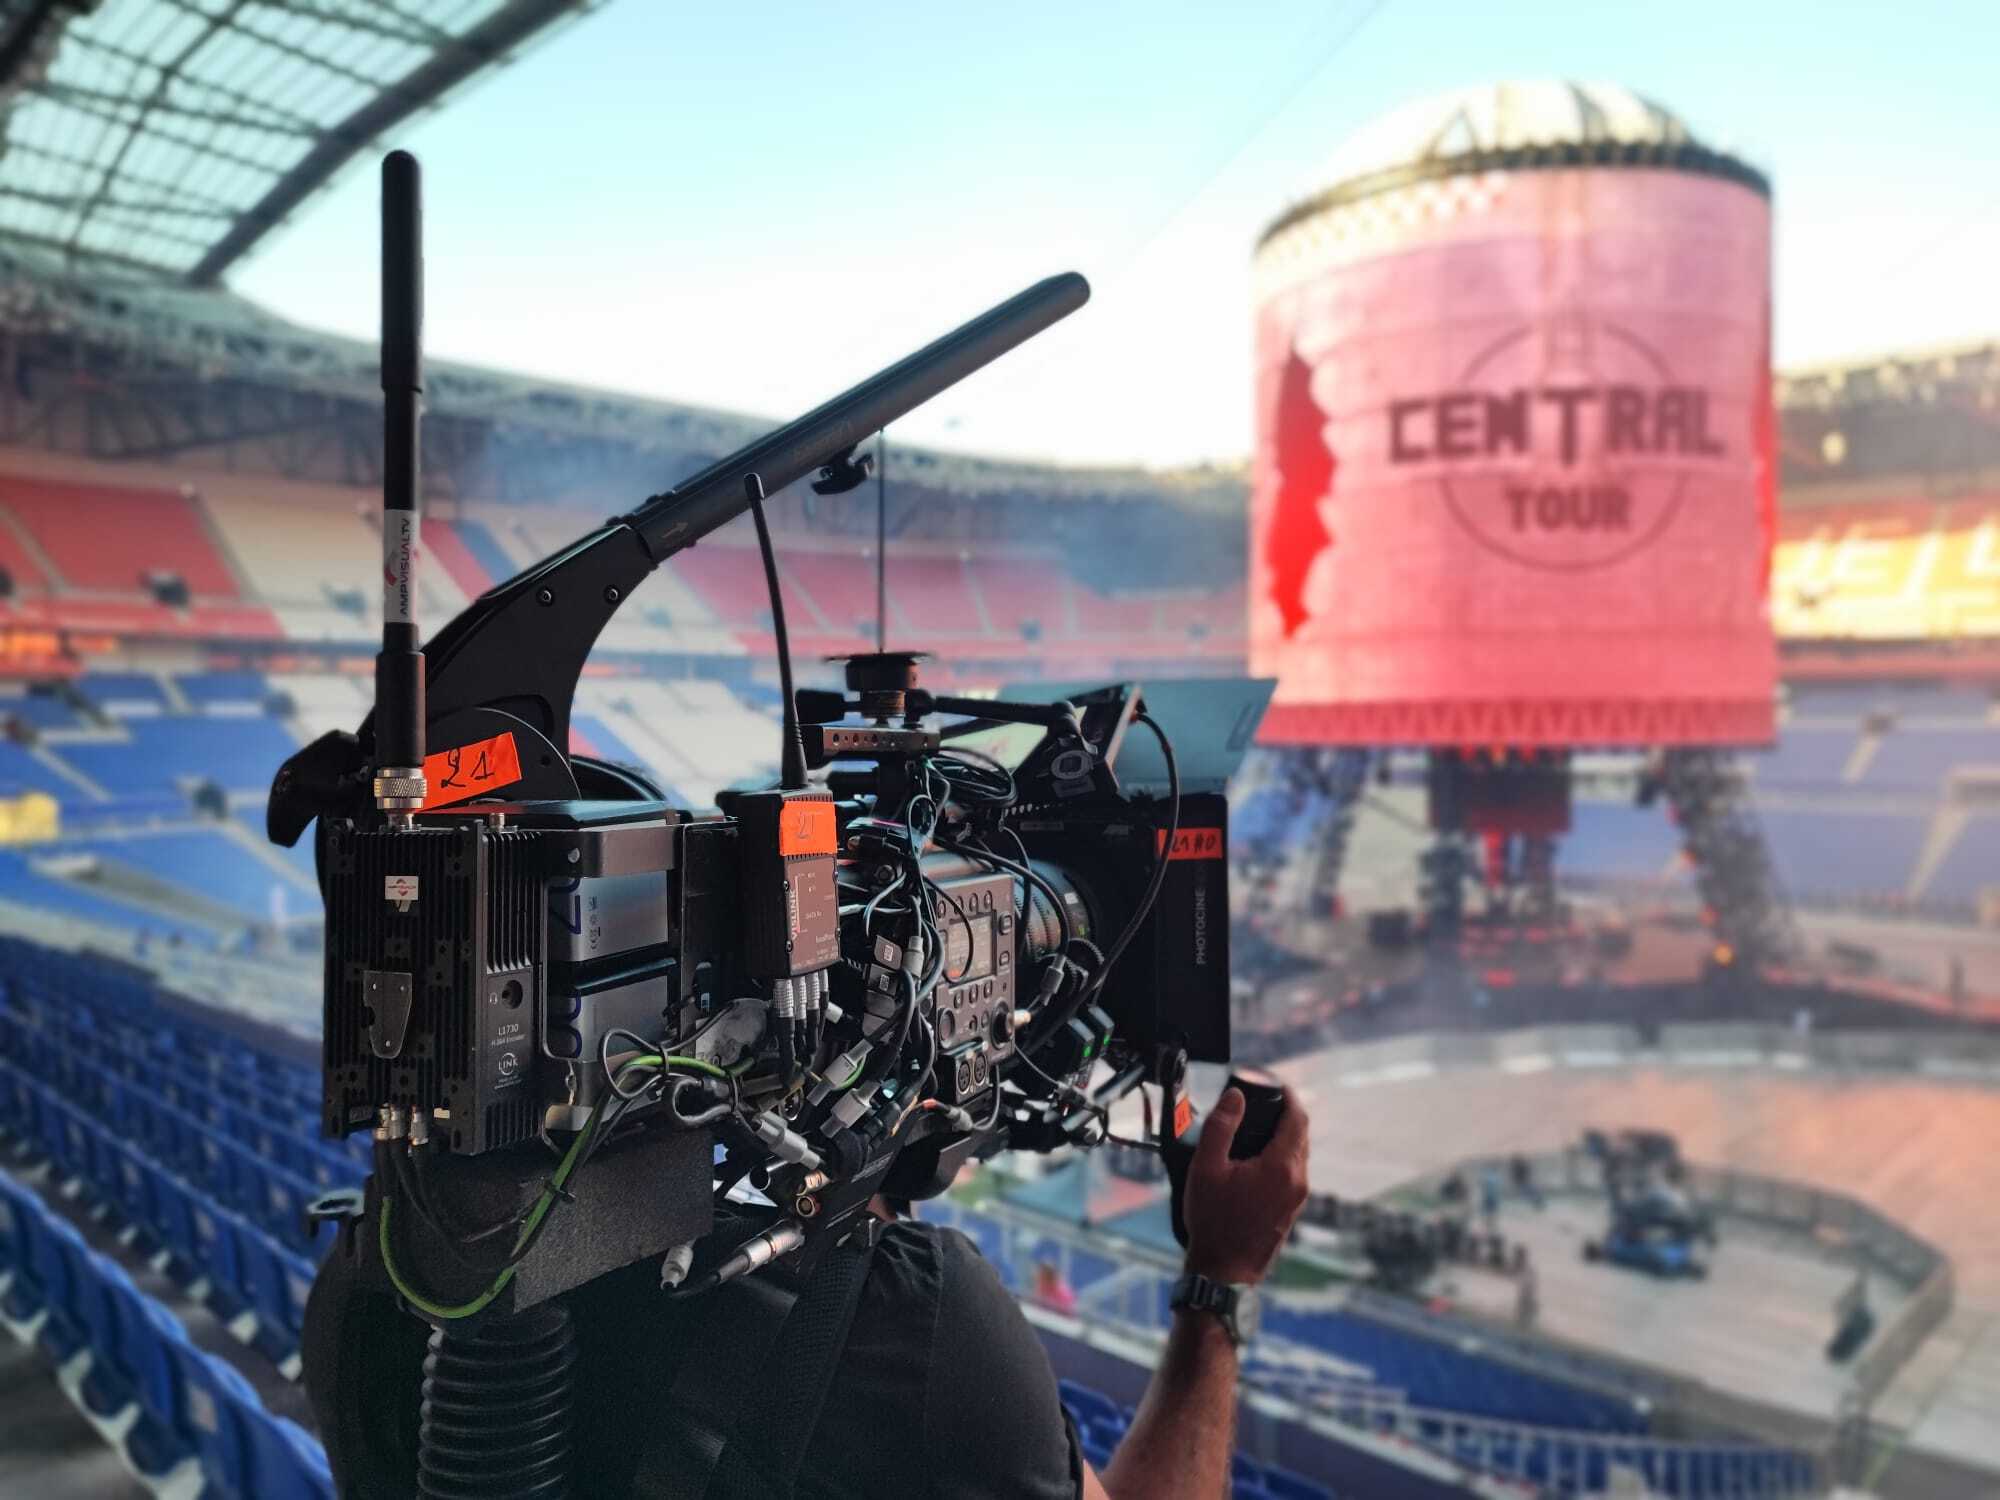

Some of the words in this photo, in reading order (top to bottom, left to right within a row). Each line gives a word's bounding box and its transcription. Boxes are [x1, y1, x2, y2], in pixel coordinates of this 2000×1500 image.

[1388, 384, 1726, 467] CENTRAL
[1507, 486, 1629, 532] TOUR
[789, 889, 797, 941] VISLINK
